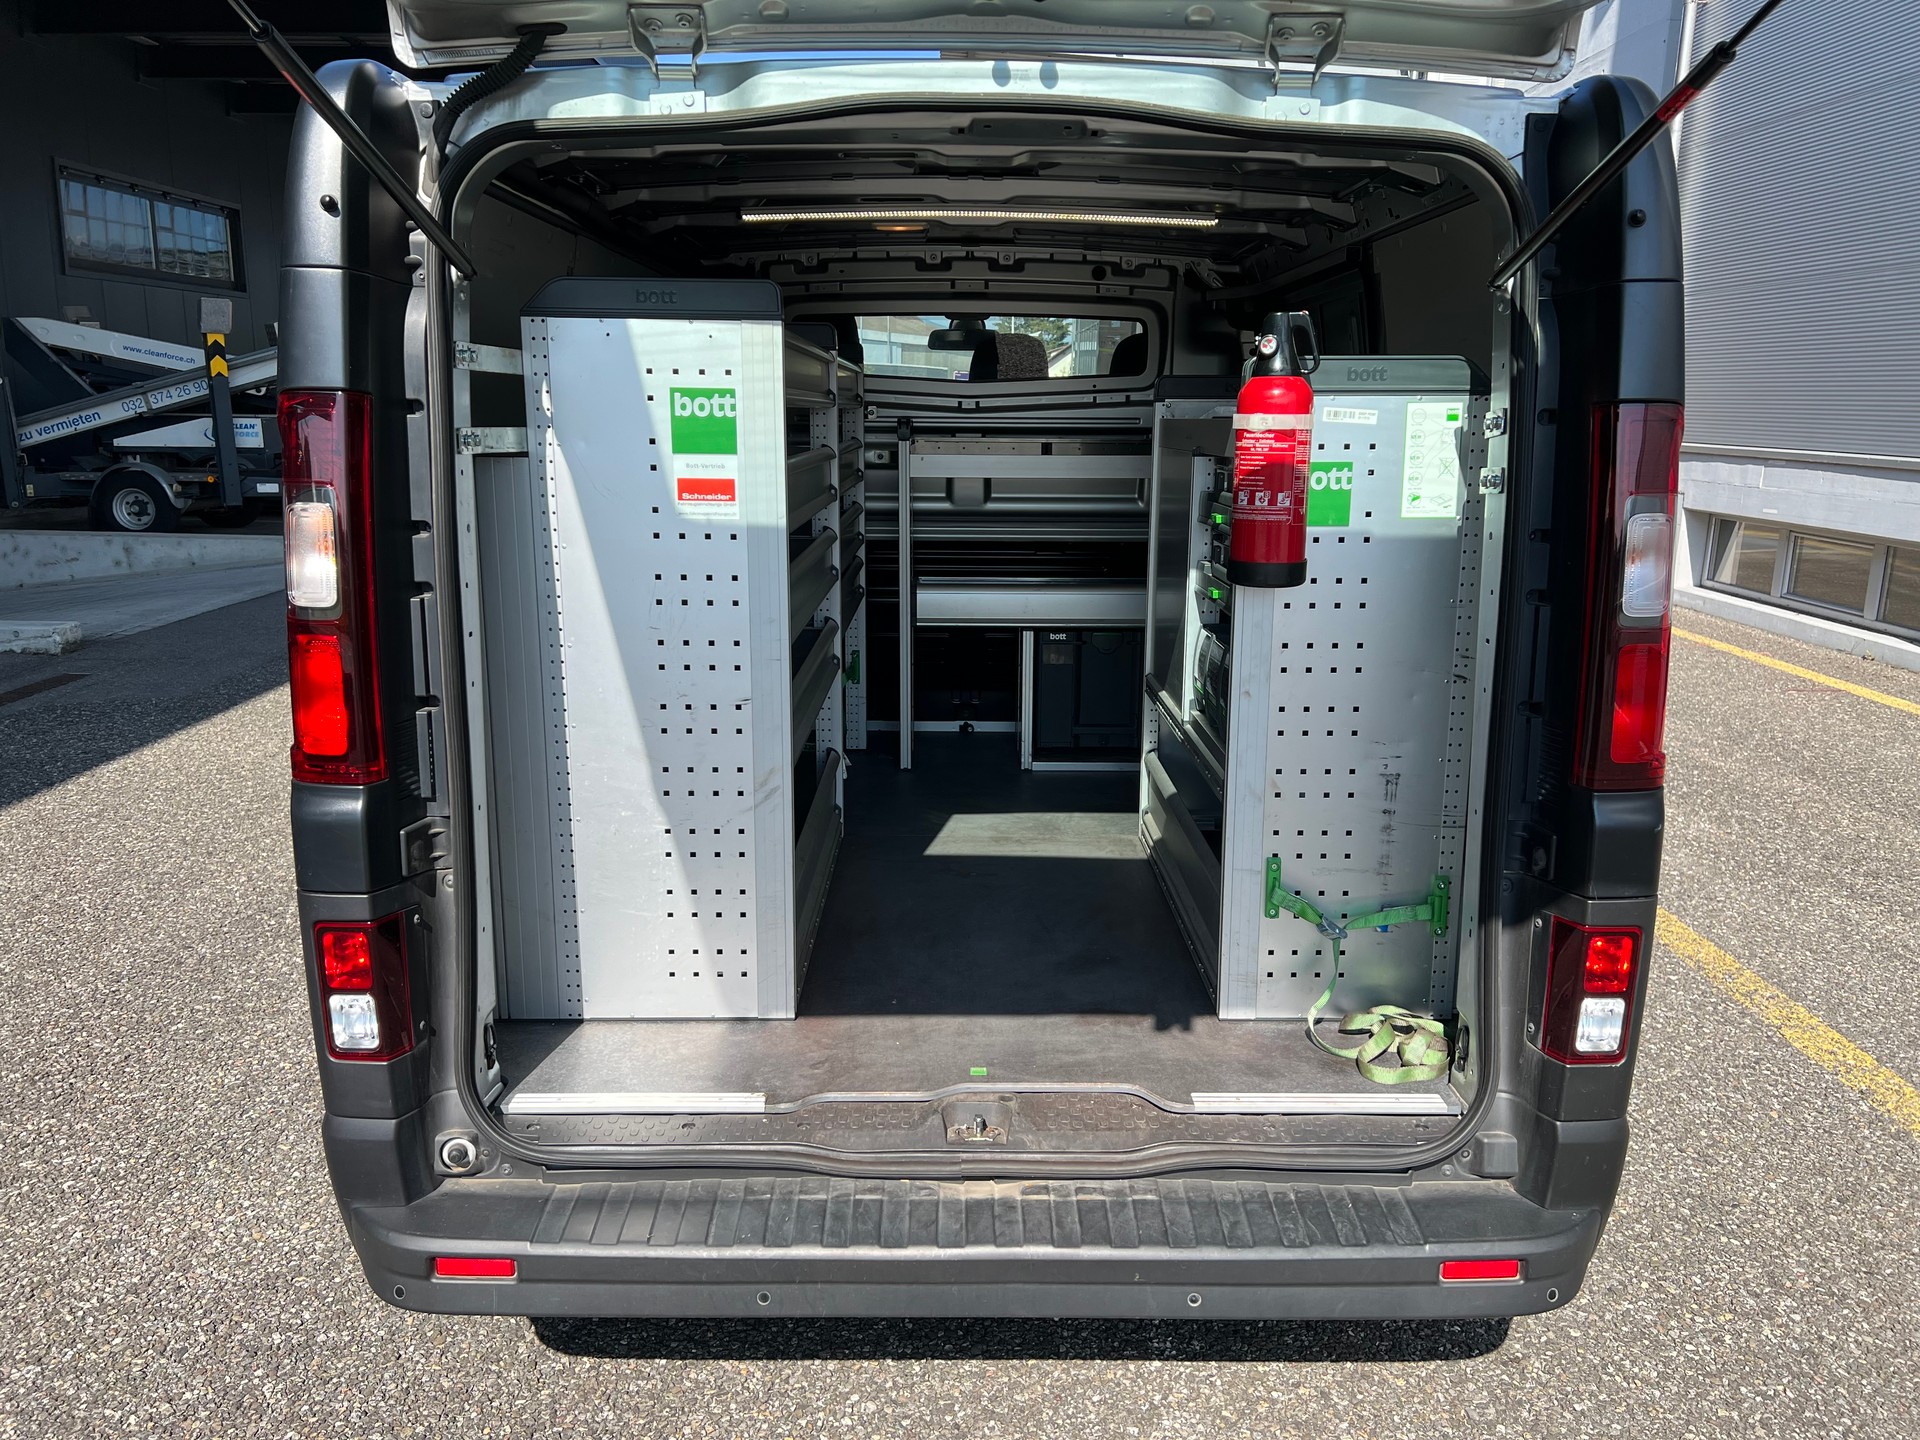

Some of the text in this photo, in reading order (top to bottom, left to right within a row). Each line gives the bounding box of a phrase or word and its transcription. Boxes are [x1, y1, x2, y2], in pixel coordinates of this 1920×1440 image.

[636, 288, 678, 304] bott
[122, 345, 196, 364] www.cleanforce.ch
[1346, 366, 1389, 382] bott
[18, 379, 209, 442] zu vermieten 032 374 26 90
[673, 392, 737, 417] bott
[1310, 467, 1353, 491] ott
[681, 492, 732, 501] Schneider
[1049, 632, 1067, 640] bott
